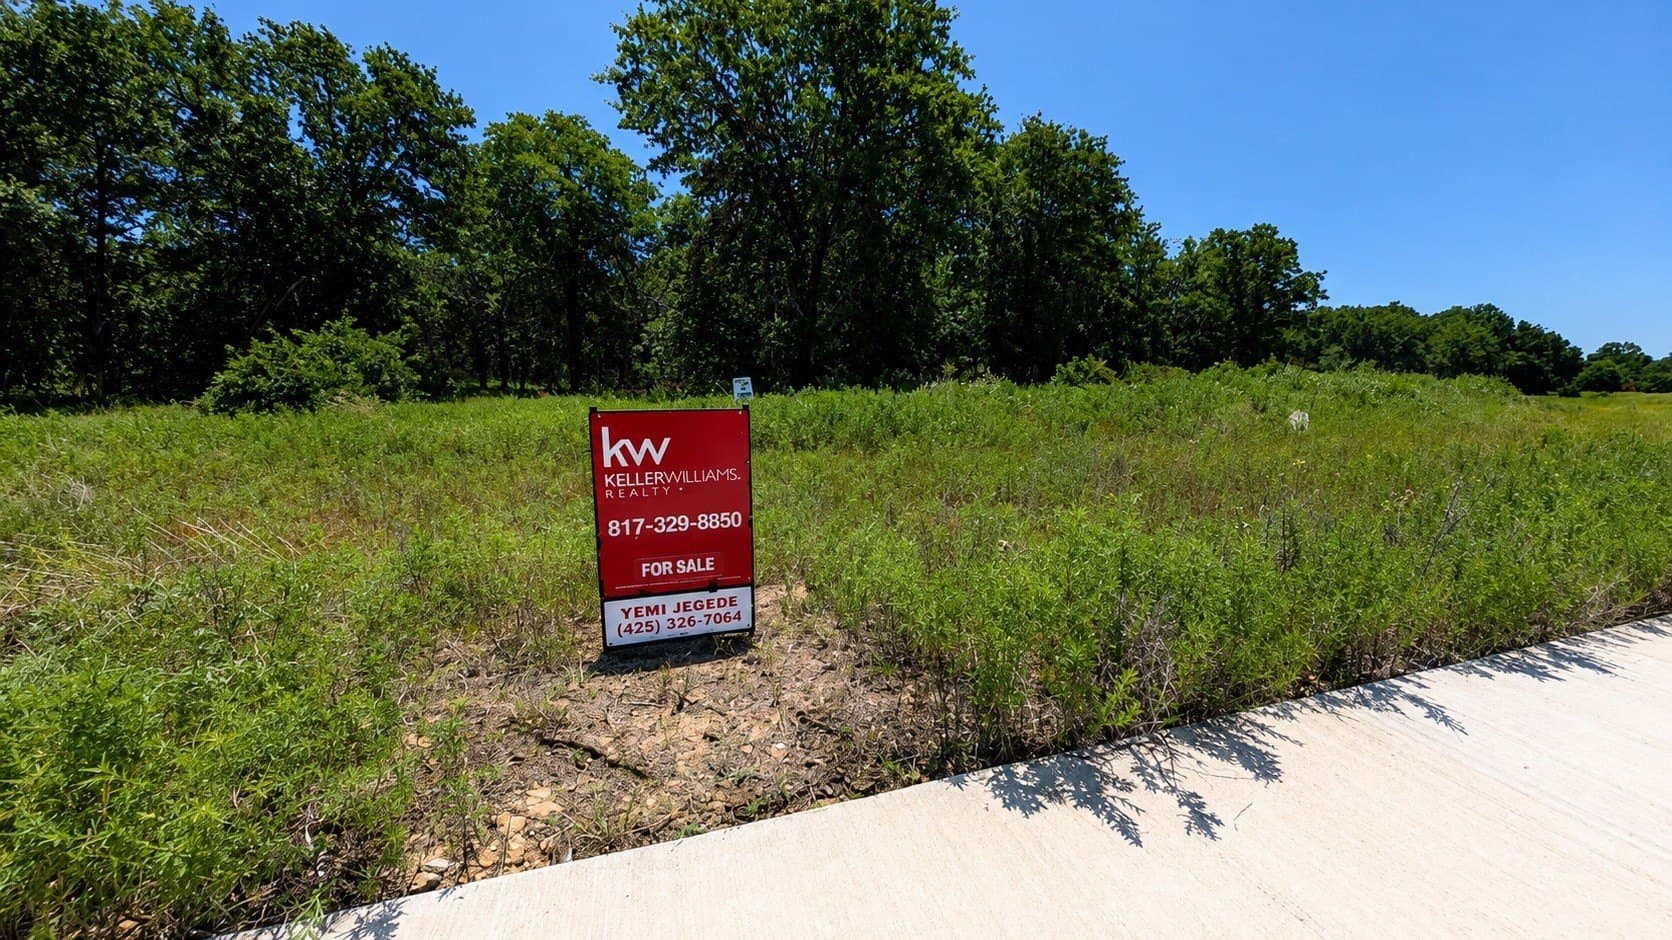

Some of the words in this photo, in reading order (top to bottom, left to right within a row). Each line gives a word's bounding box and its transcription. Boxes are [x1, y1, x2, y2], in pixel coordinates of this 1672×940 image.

[602, 426, 671, 468] kw
[606, 486, 671, 499] REALTY
[608, 511, 742, 537] 817-329-8850
[641, 561, 673, 577] FOR
[676, 557, 715, 574] SALE
[621, 604, 667, 620] YEMI
[673, 596, 738, 614] JEGEDE
[617, 619, 661, 638] (425)
[667, 610, 742, 630] 326-7064
